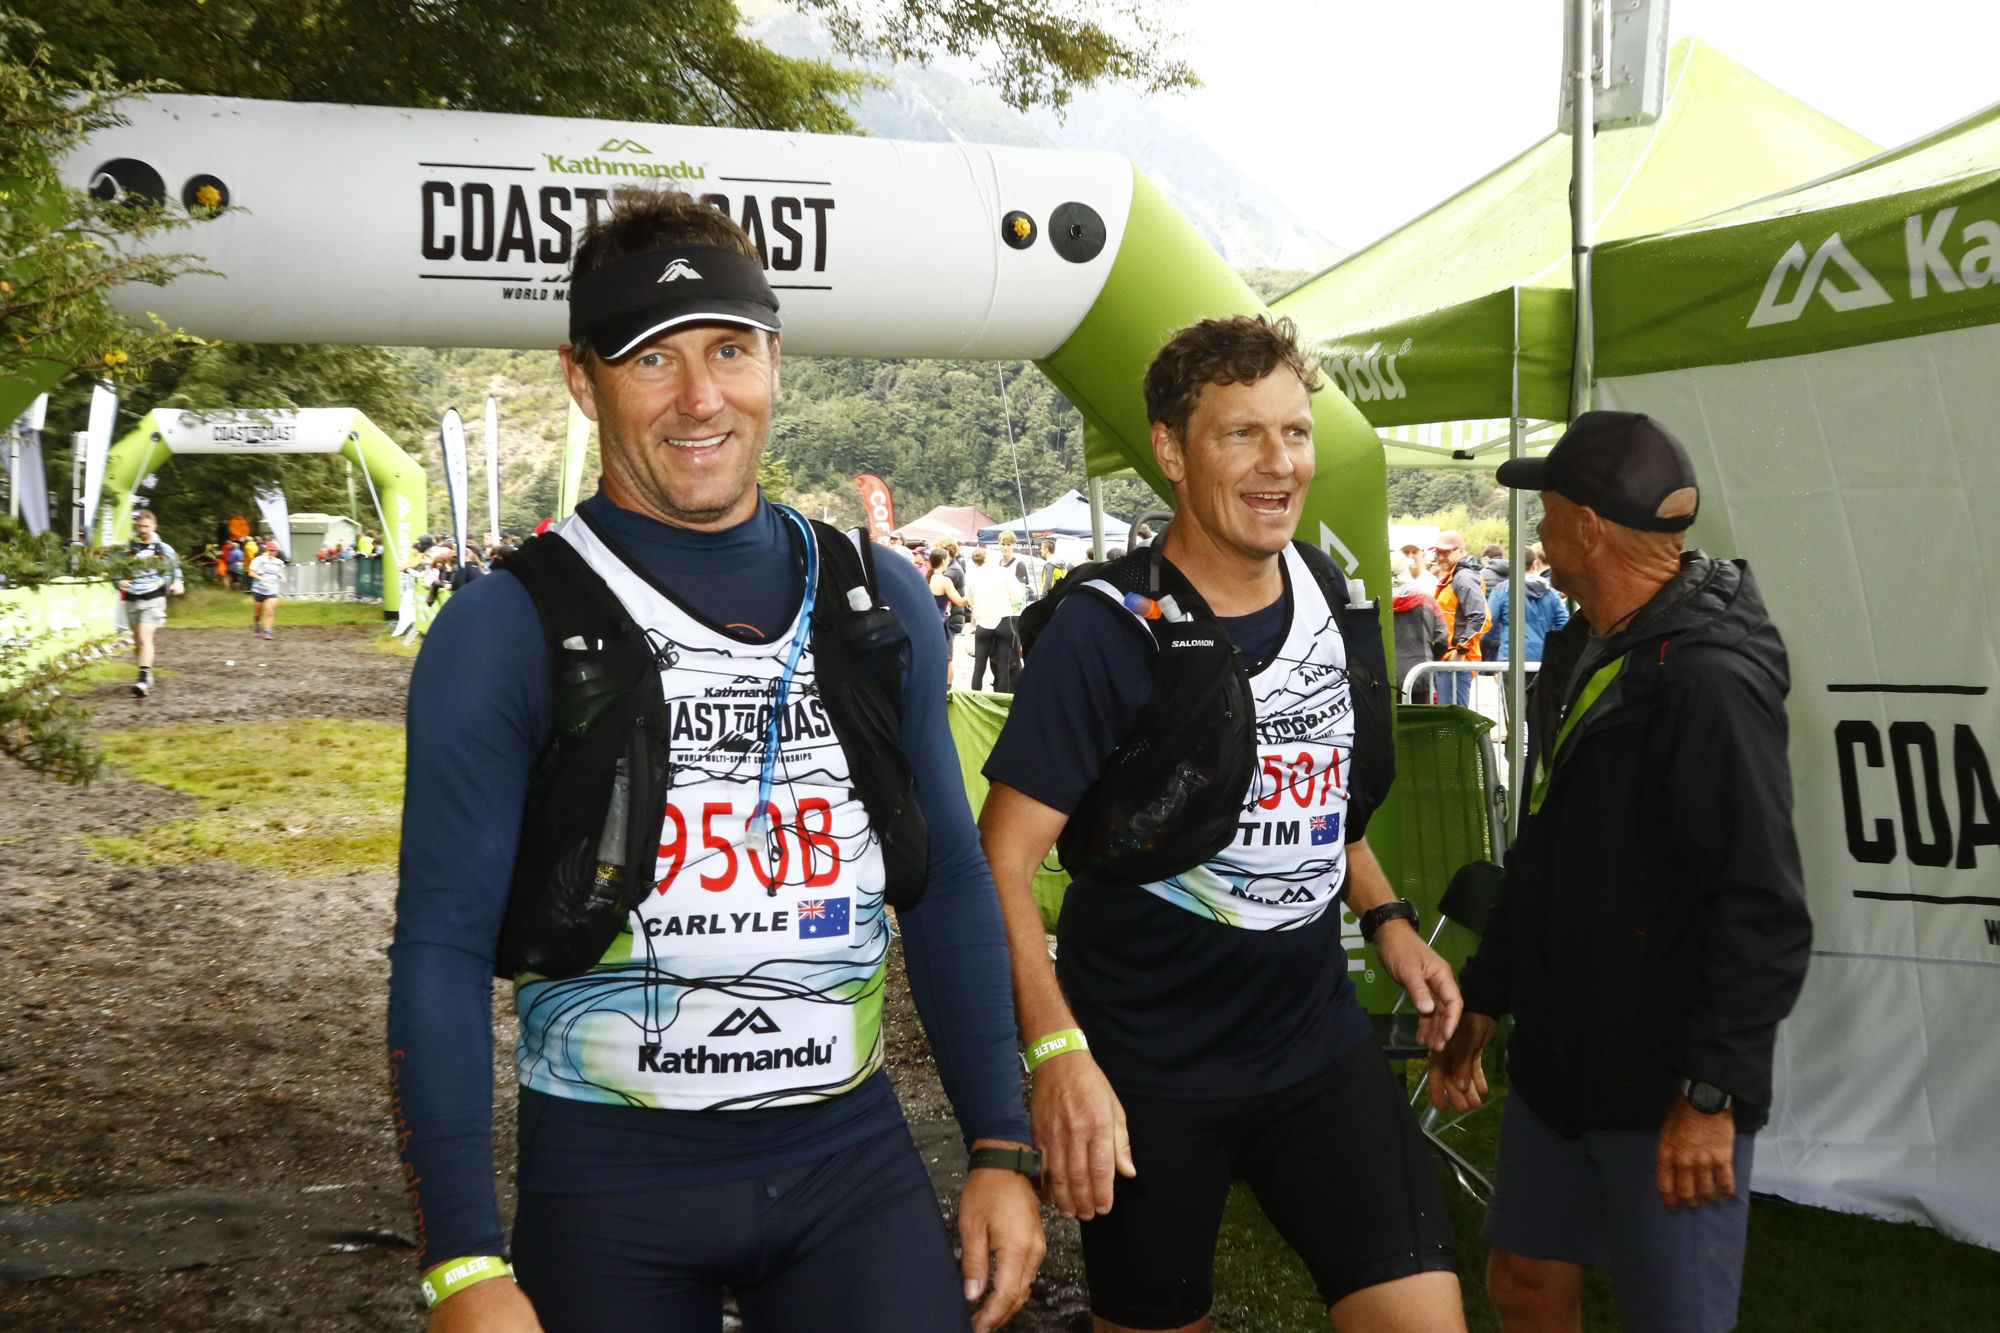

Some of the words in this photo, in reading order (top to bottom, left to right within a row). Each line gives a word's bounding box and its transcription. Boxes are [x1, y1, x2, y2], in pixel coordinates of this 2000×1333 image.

[548, 153, 706, 180] Kathmandu
[1904, 205, 2000, 300] Ka
[503, 287, 548, 301] WORLD
[1171, 639, 1214, 648] SALOMON
[704, 687, 776, 698] Kathmand
[1238, 820, 1300, 846] TIM
[645, 911, 789, 937] CARLYLE
[638, 1037, 832, 1075] Kathmandu
[1034, 1036, 1067, 1060] ATHLETE
[444, 1256, 491, 1287] ATHLETE
